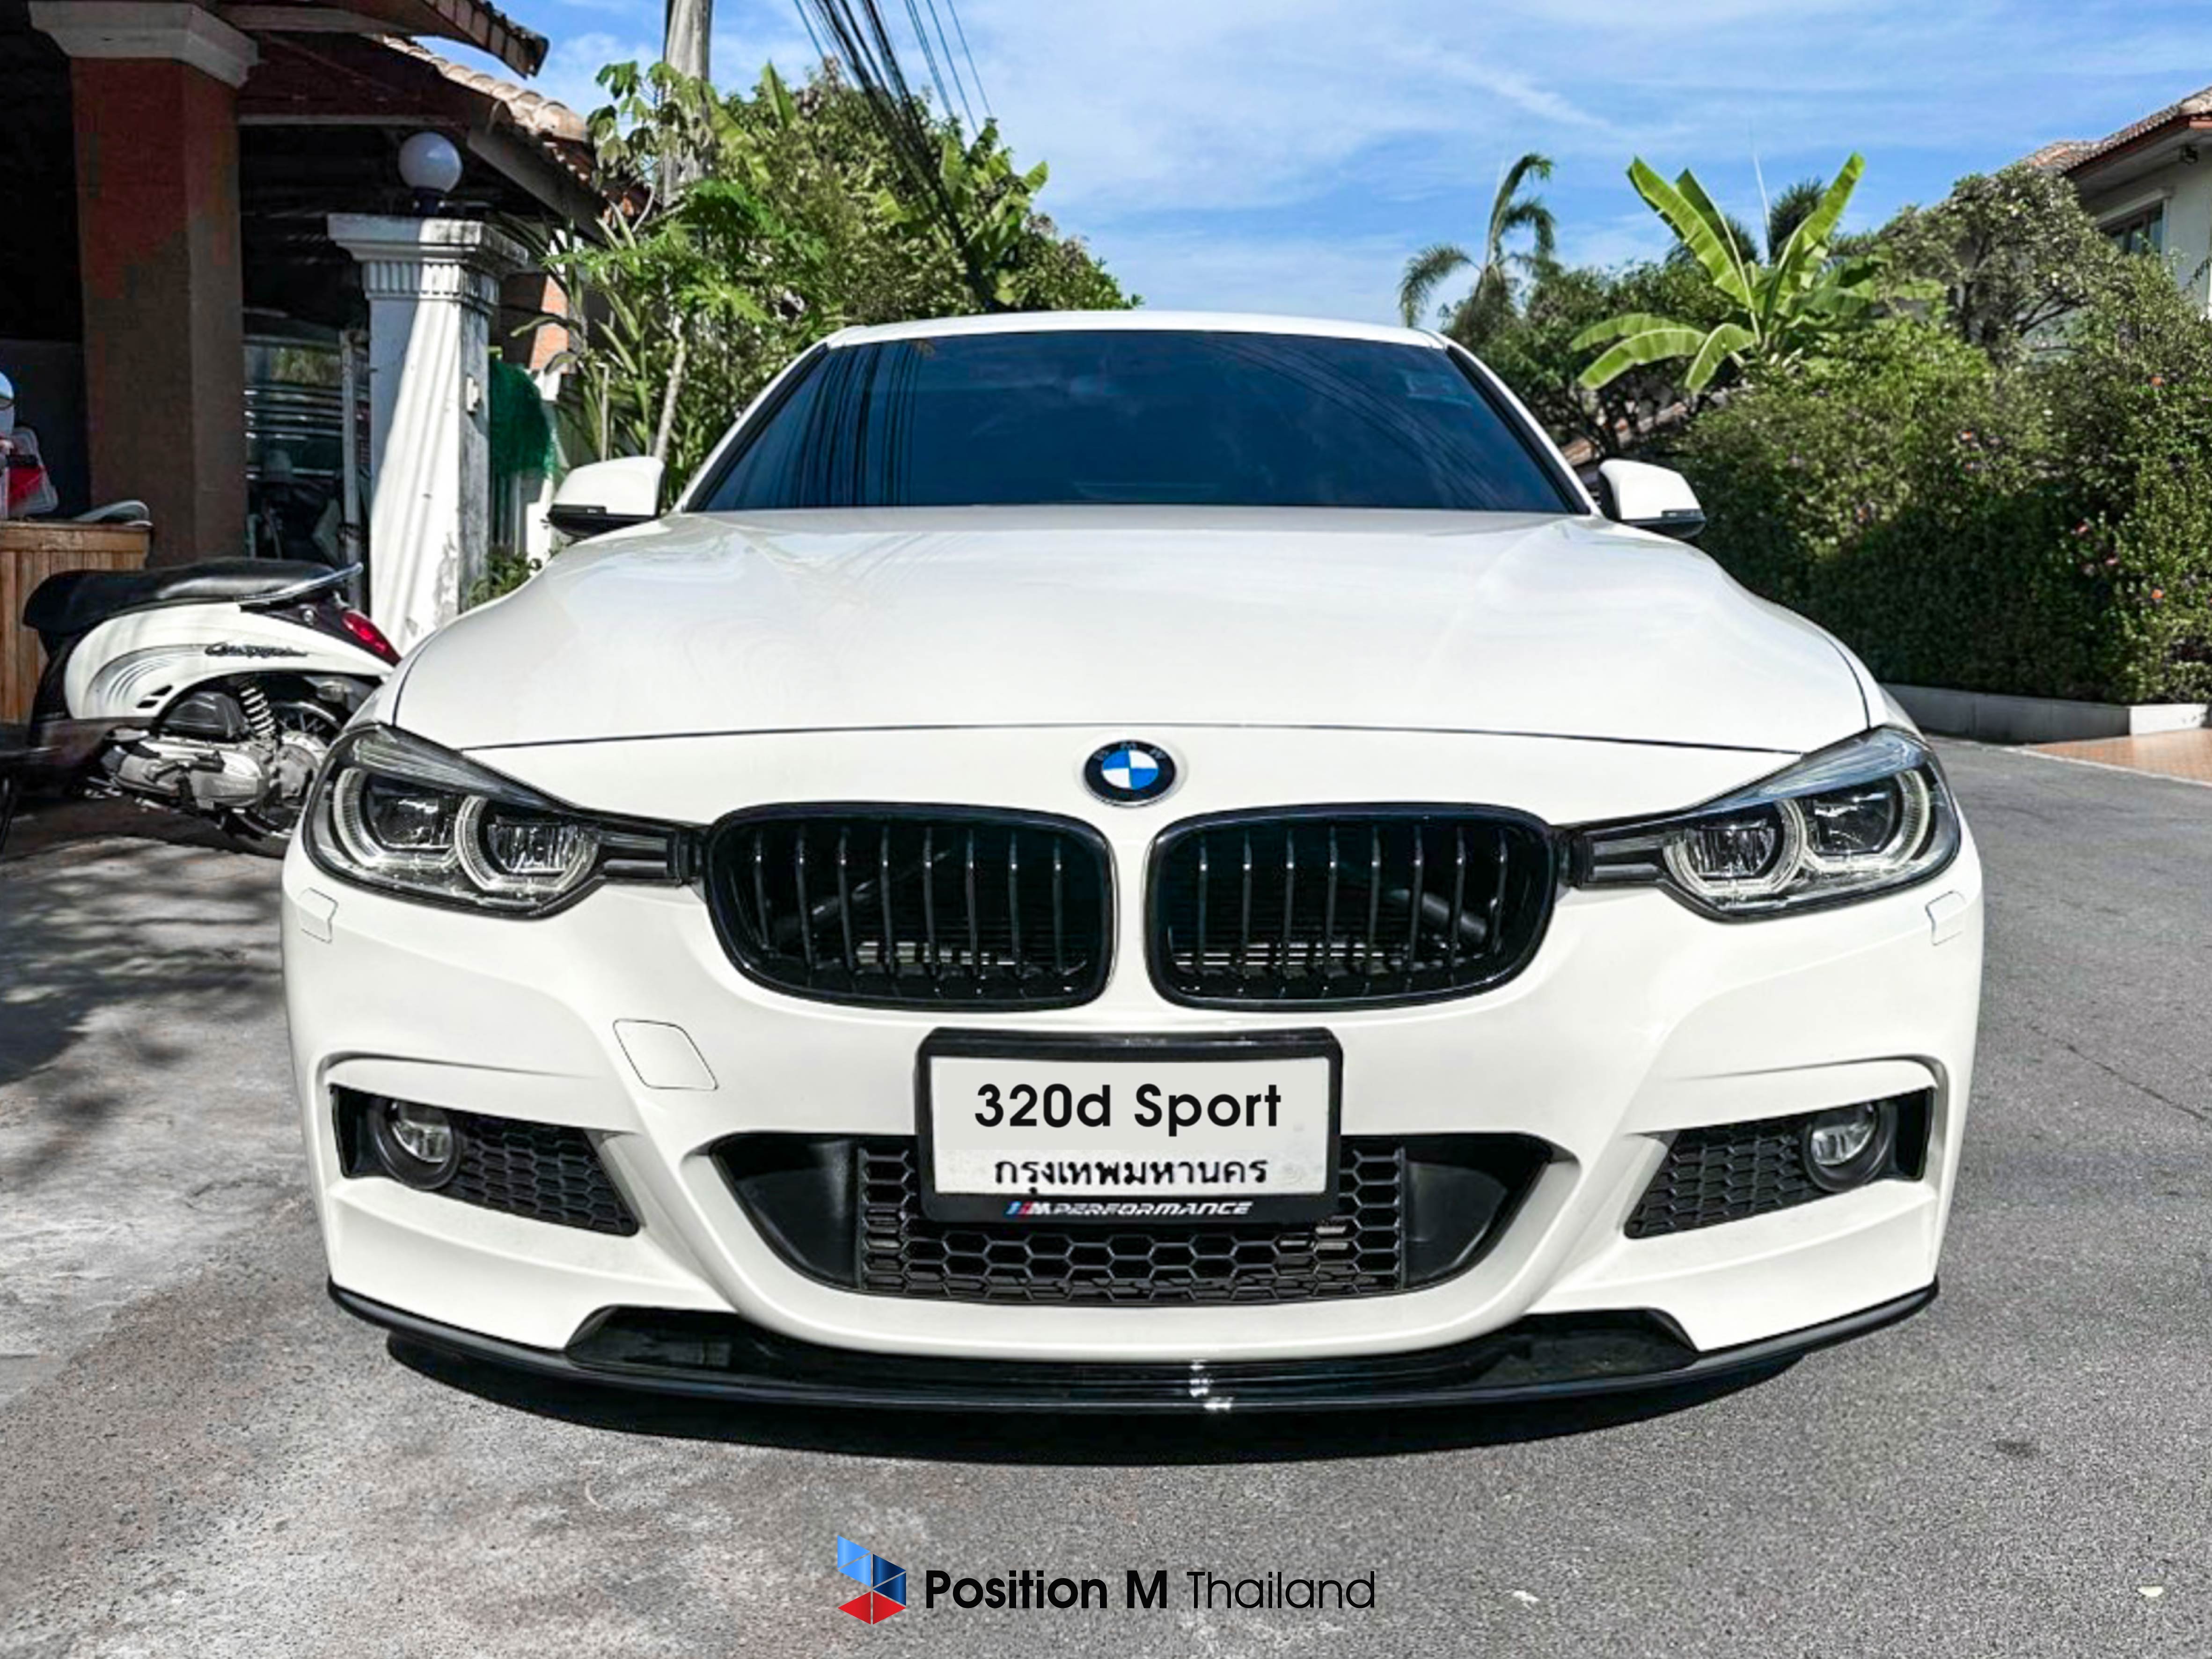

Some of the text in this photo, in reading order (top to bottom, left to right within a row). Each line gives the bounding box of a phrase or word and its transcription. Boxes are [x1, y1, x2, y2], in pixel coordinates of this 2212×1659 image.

[995, 1160, 1268, 1195] กรุงเทพมหานคร
